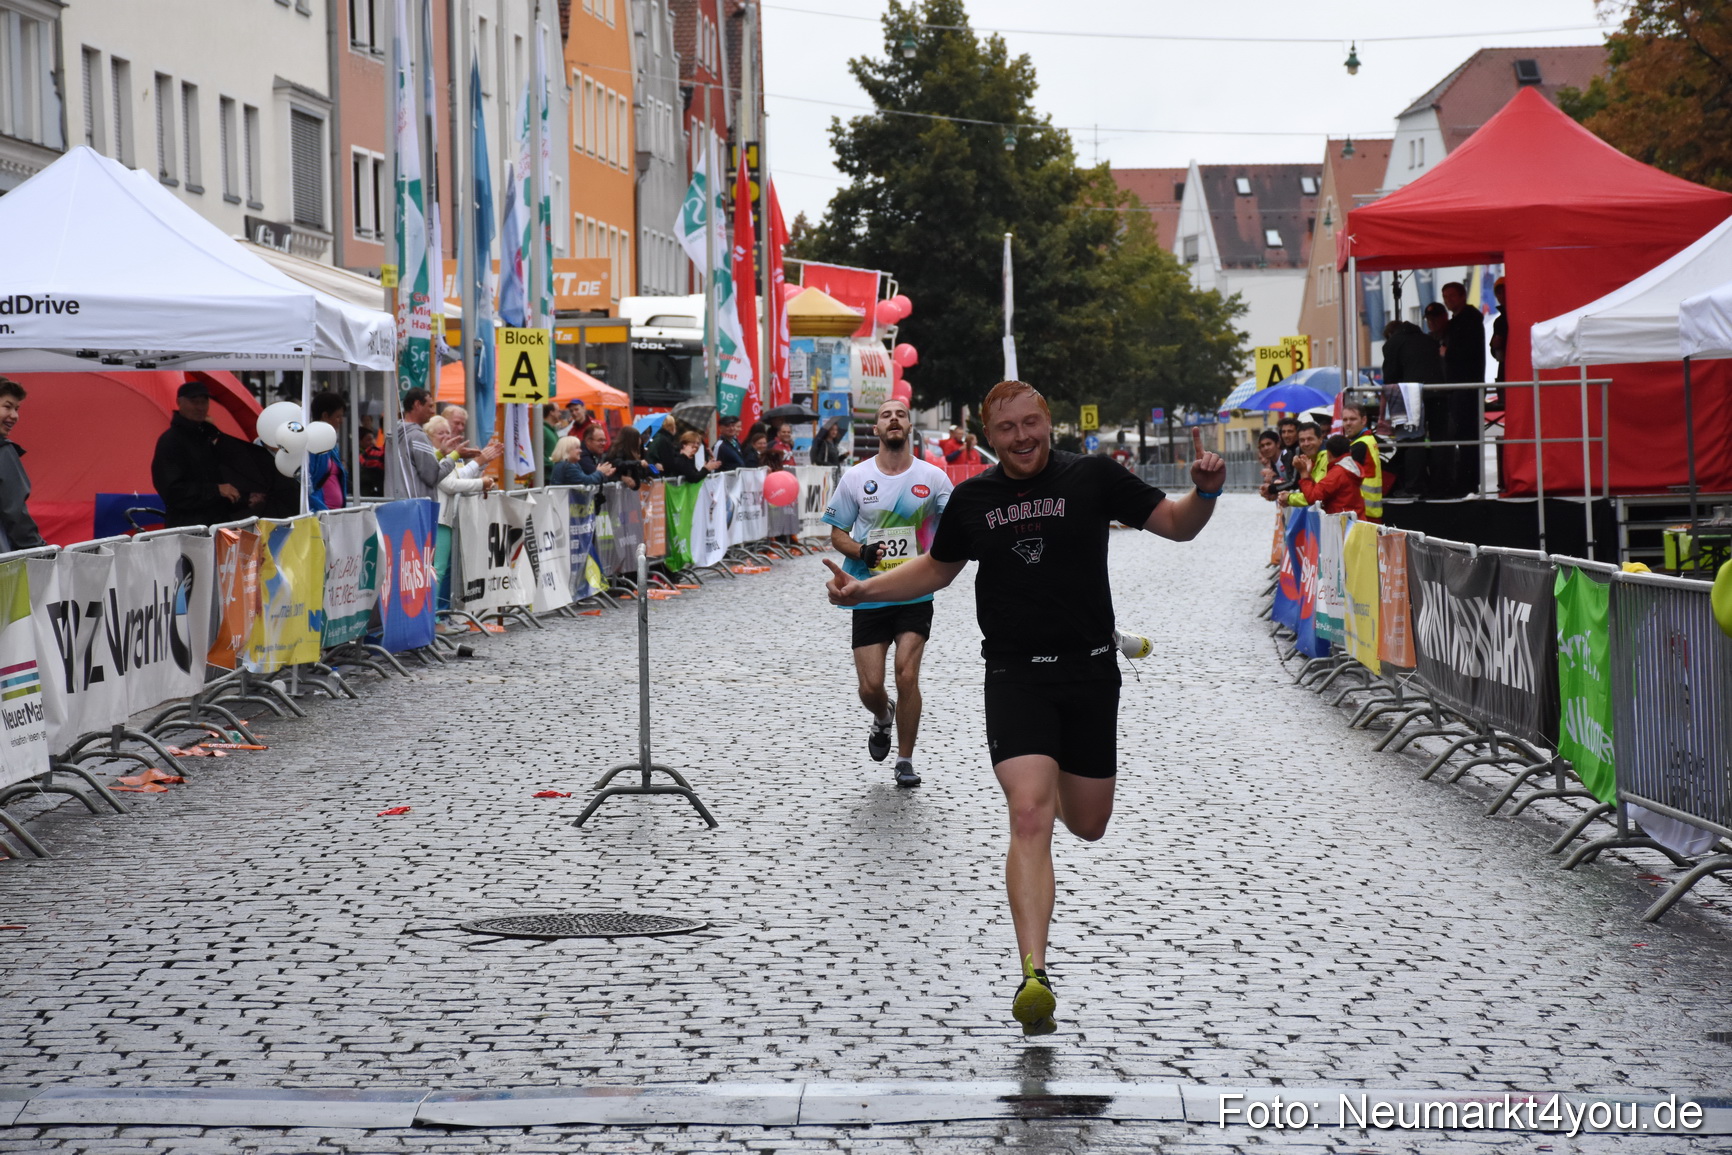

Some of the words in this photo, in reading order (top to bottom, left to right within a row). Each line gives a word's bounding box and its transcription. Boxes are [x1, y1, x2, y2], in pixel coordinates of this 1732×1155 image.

[505, 330, 544, 345] Block
[1260, 348, 1292, 360] Block
[509, 350, 538, 388] A
[859, 349, 887, 378] AVIA
[1085, 411, 1095, 425] D
[985, 497, 1066, 530] FLORIDA
[1013, 522, 1042, 534] TECH
[1090, 645, 1110, 657] 2XU
[1031, 655, 1059, 663] 2XU
